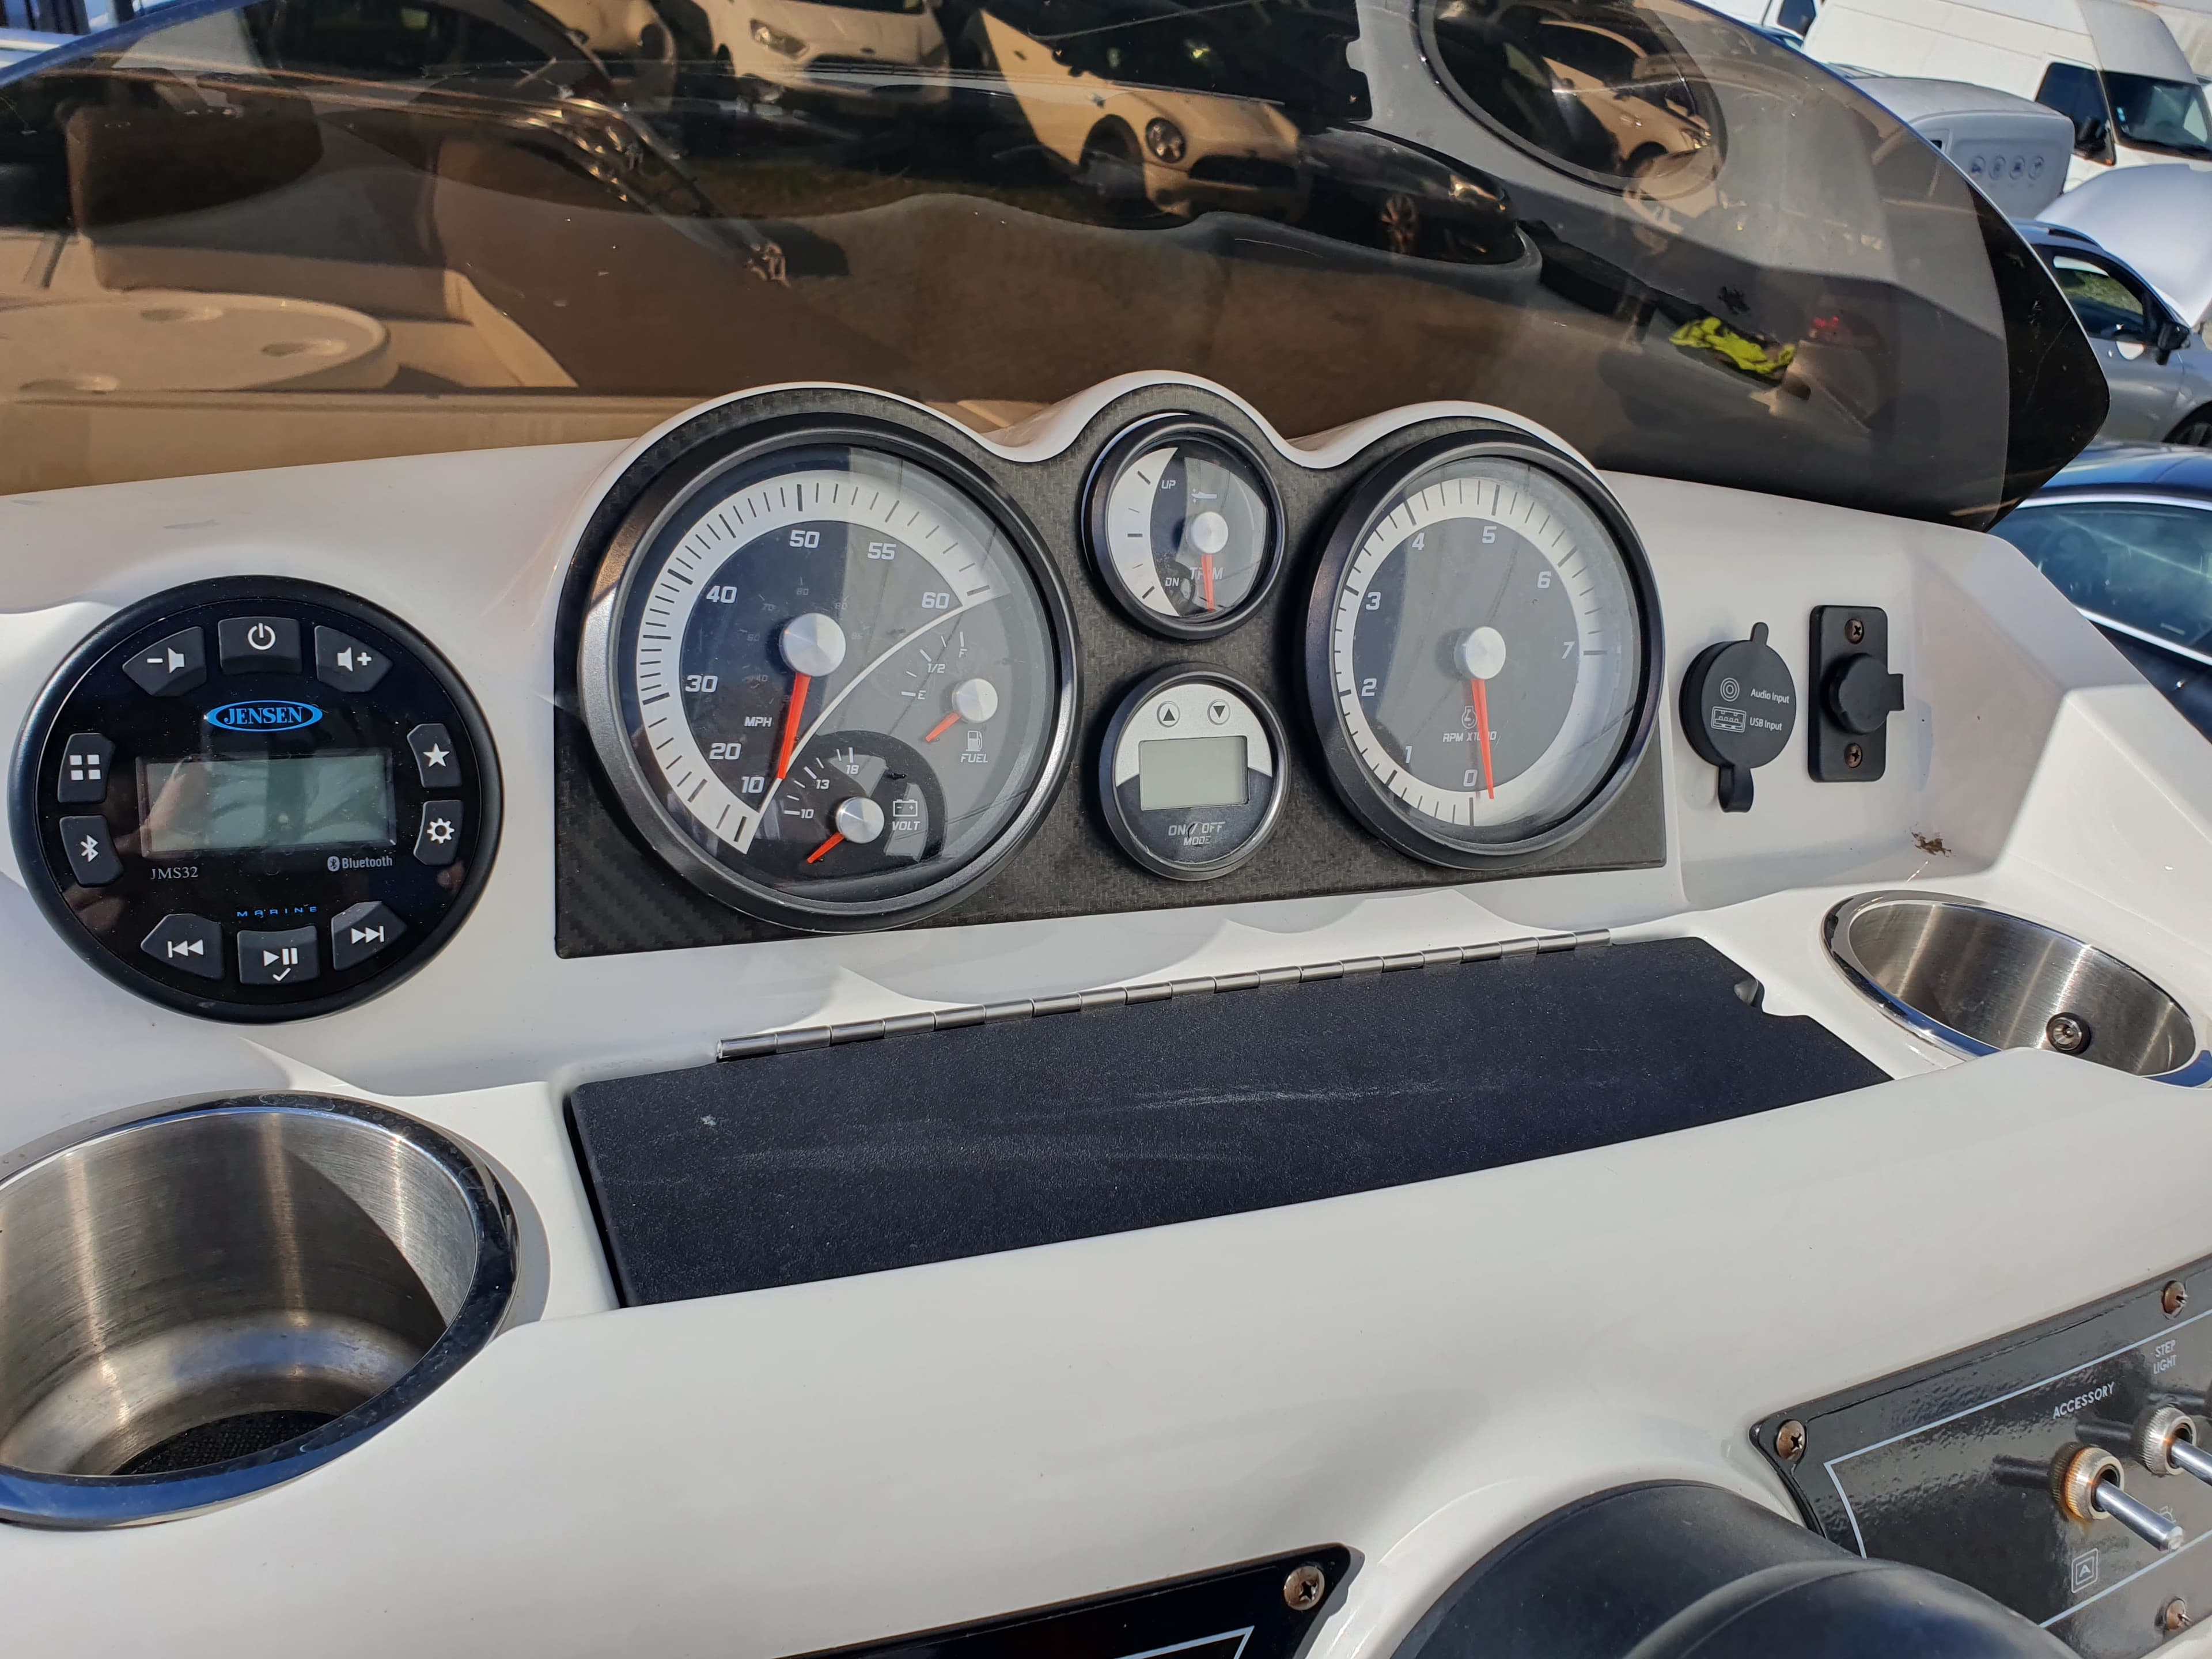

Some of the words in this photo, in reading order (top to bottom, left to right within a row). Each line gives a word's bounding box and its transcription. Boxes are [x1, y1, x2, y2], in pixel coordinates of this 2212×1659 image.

[1161, 479, 1176, 489] UP
[789, 529, 820, 549] 50
[1411, 532, 1425, 551] 4
[1482, 525, 1497, 544] 5
[867, 541, 897, 560] 55
[1164, 577, 1180, 587] DN
[1537, 571, 1552, 589] 6
[706, 585, 737, 604] 40
[922, 592, 950, 609] 60
[1365, 591, 1381, 611] 3
[959, 648, 968, 658] F
[1562, 641, 1575, 660] 7
[927, 663, 946, 673] 1/2
[685, 675, 718, 693] 30
[1361, 678, 1377, 696] 2
[917, 690, 927, 700] E
[1751, 688, 1771, 700] Audio
[1772, 692, 1790, 703] Input
[224, 706, 303, 725] JENSEN
[744, 716, 773, 728] MPH
[1749, 717, 1763, 728] USB
[1764, 719, 1782, 731] Input
[1442, 732, 1464, 743] RPM
[709, 743, 742, 760] 20
[960, 753, 988, 763] FUEL
[1405, 745, 1412, 764] 1
[845, 764, 859, 775] 18
[1463, 769, 1478, 787] 0
[741, 776, 765, 794] 10
[815, 779, 830, 790] 13
[800, 809, 815, 819] 10
[892, 820, 921, 831] VOLT
[1183, 836, 1211, 846] MODE
[342, 855, 393, 869] Bluetooth
[150, 866, 199, 880] JMS32
[236, 906, 318, 917] MARINE
[2155, 1339, 2176, 1358] STEP
[2153, 1354, 2177, 1374] LIGHT
[2052, 1381, 2115, 1420] ACCESSORY
